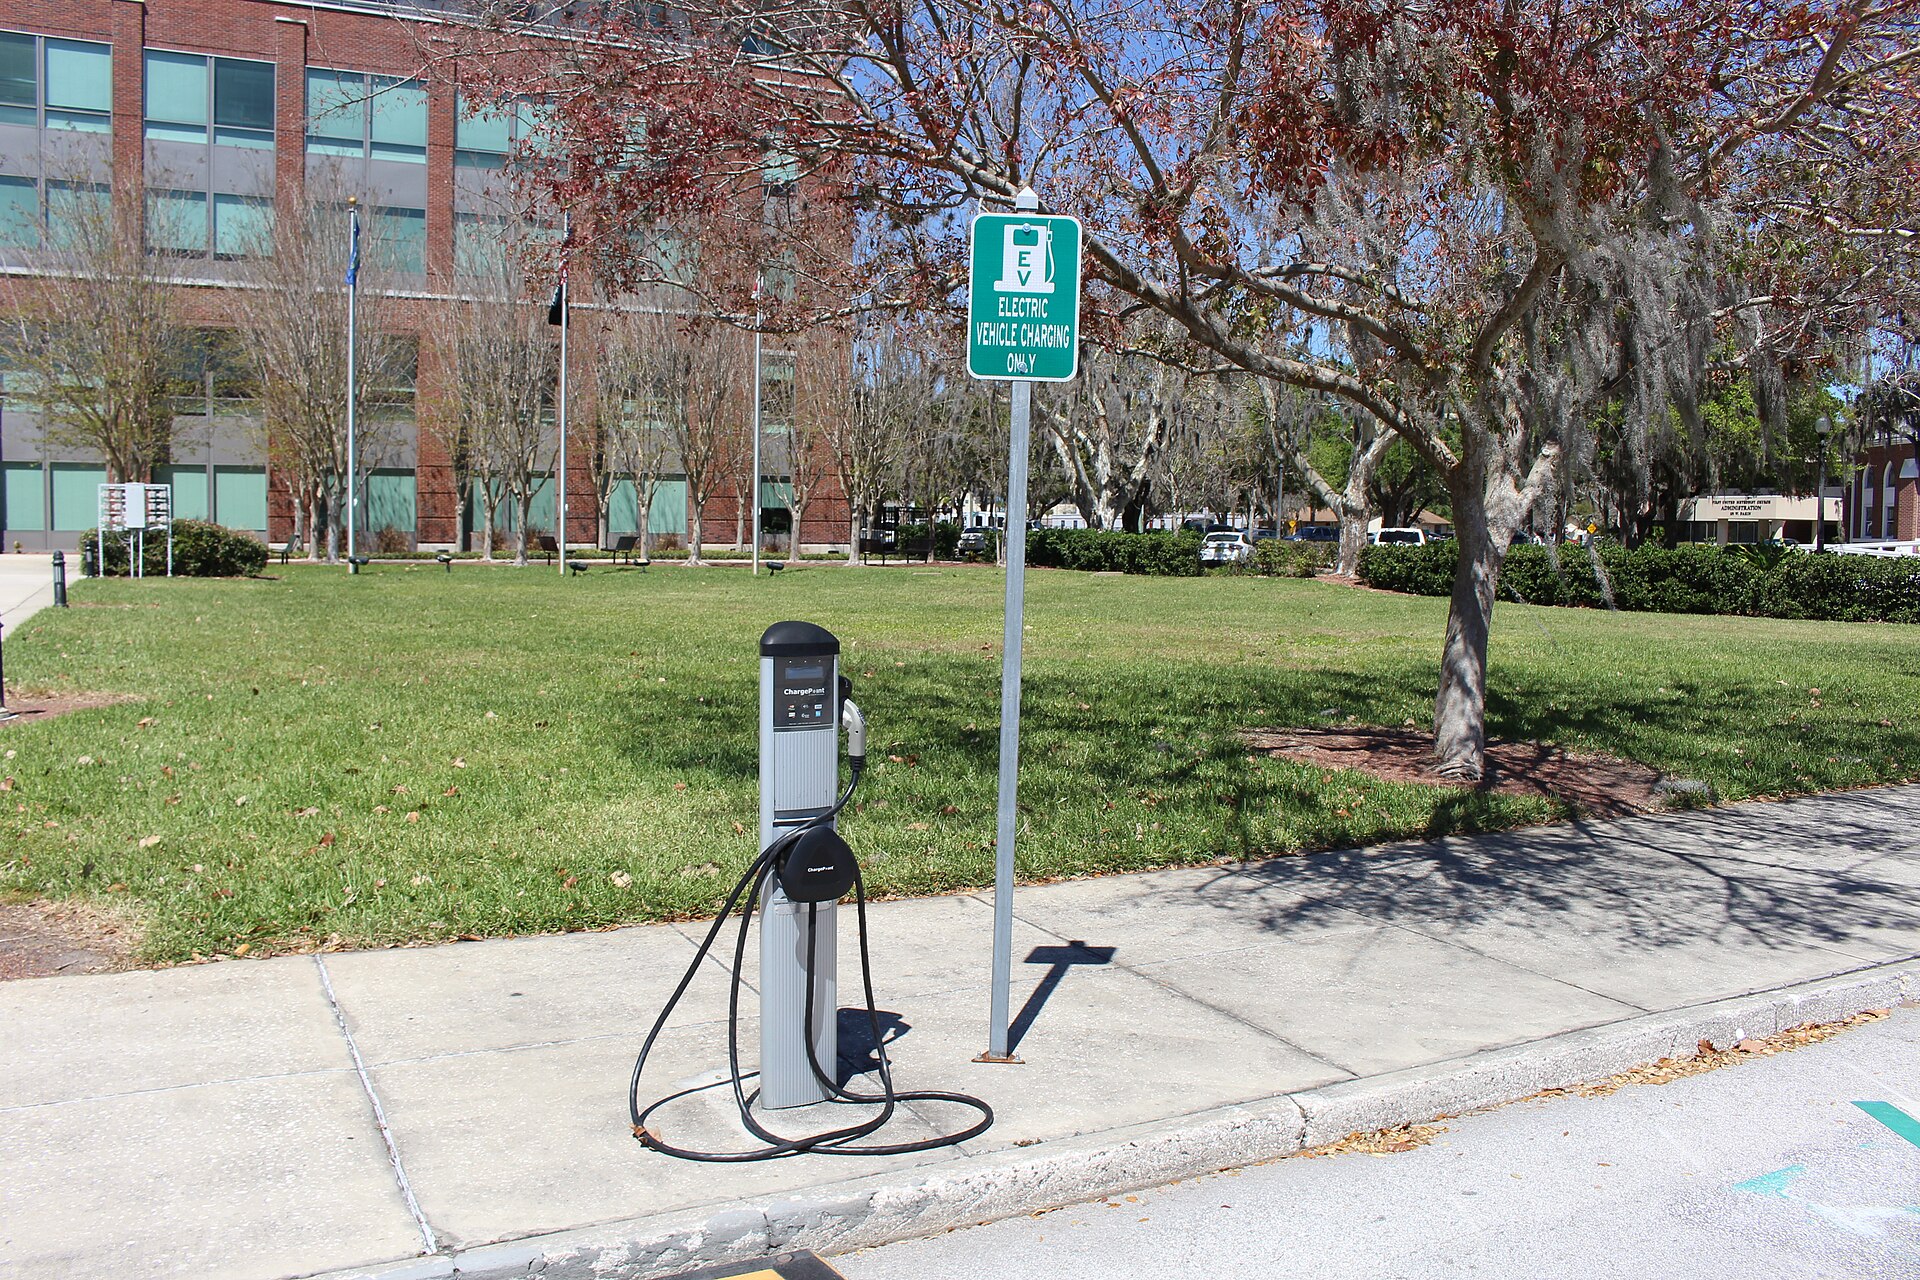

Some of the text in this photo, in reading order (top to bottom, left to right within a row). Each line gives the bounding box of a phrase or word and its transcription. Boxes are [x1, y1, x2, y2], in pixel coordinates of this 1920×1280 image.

[998, 297, 1049, 318] ELECTRIC
[976, 322, 1070, 348] VEHICLE CHARGING
[784, 687, 825, 696] ChargePoint
